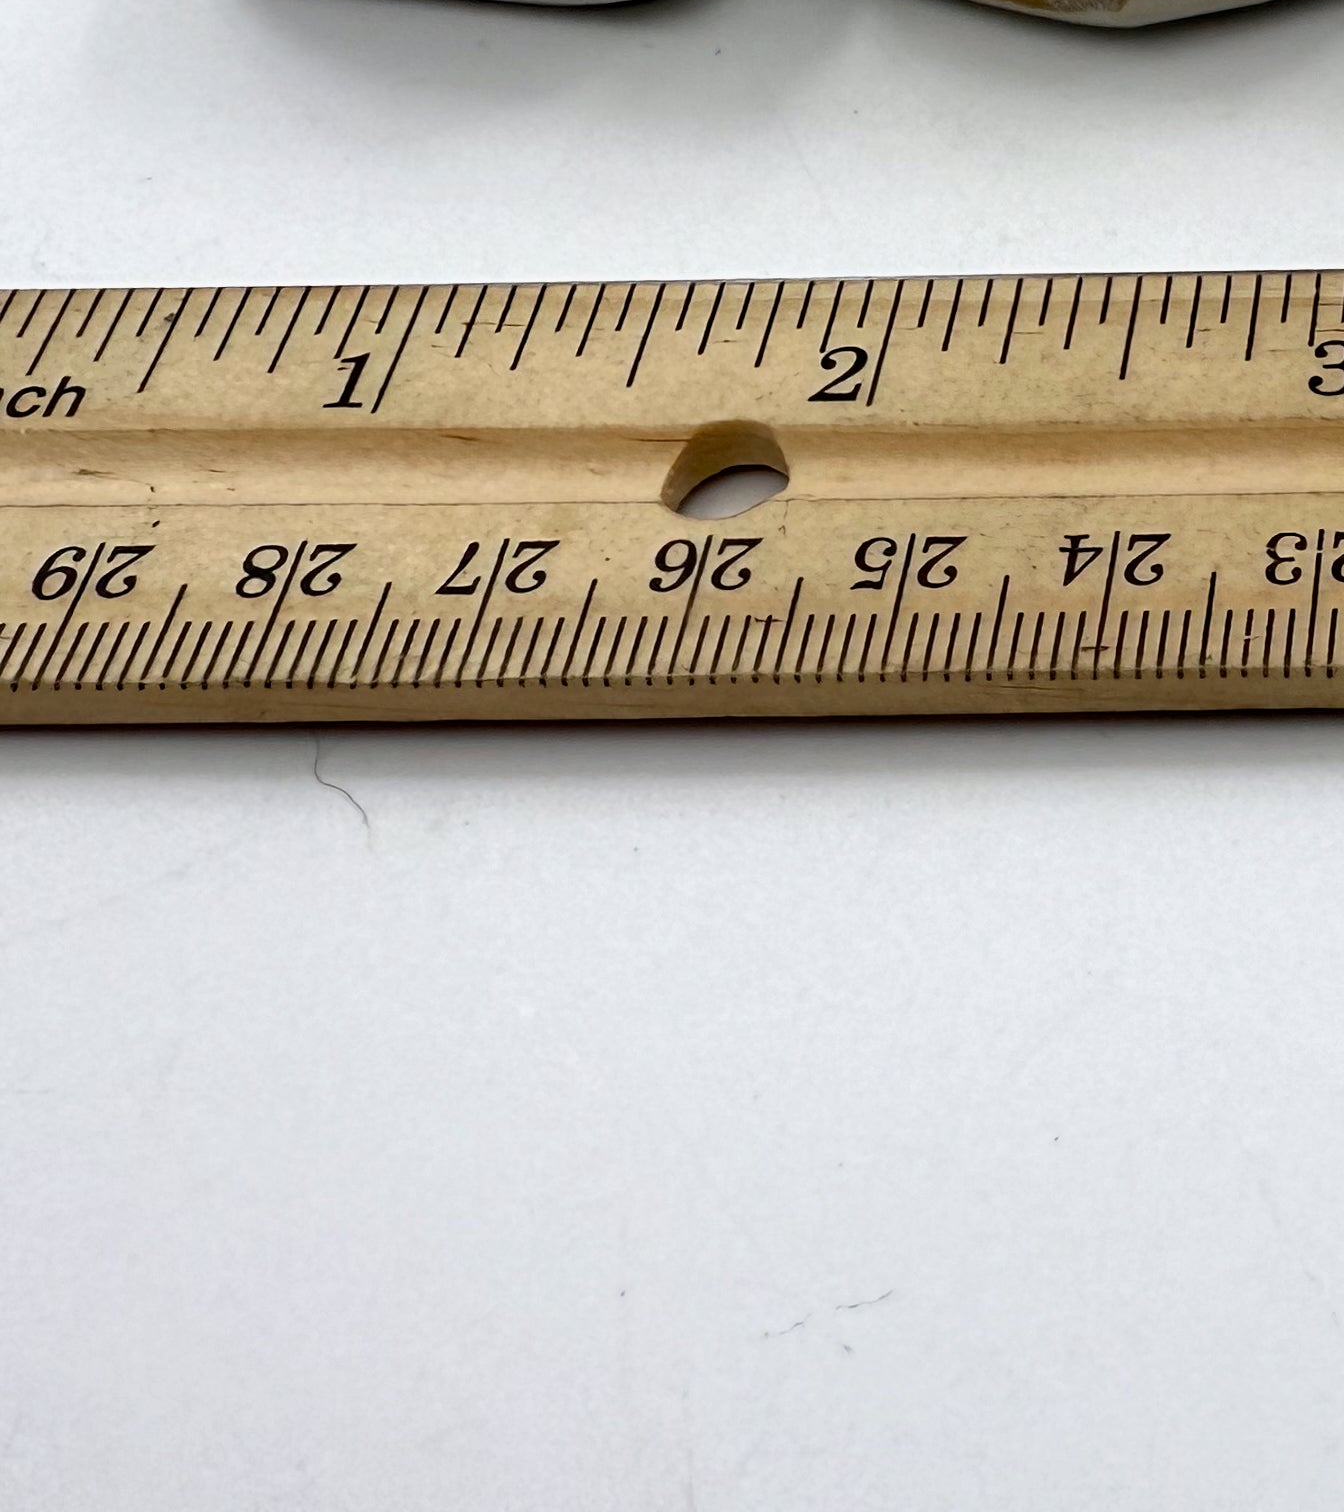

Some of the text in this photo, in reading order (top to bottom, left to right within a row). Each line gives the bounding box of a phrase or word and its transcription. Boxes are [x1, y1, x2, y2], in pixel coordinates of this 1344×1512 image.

[0, 376, 86, 418] ch
[323, 353, 371, 409] 1
[808, 347, 869, 402] 2
[32, 545, 156, 600] 29
[236, 544, 357, 598] 28
[435, 540, 560, 595] 27
[649, 538, 763, 592] 26
[850, 536, 967, 590] 25
[1059, 534, 1171, 586] 24
